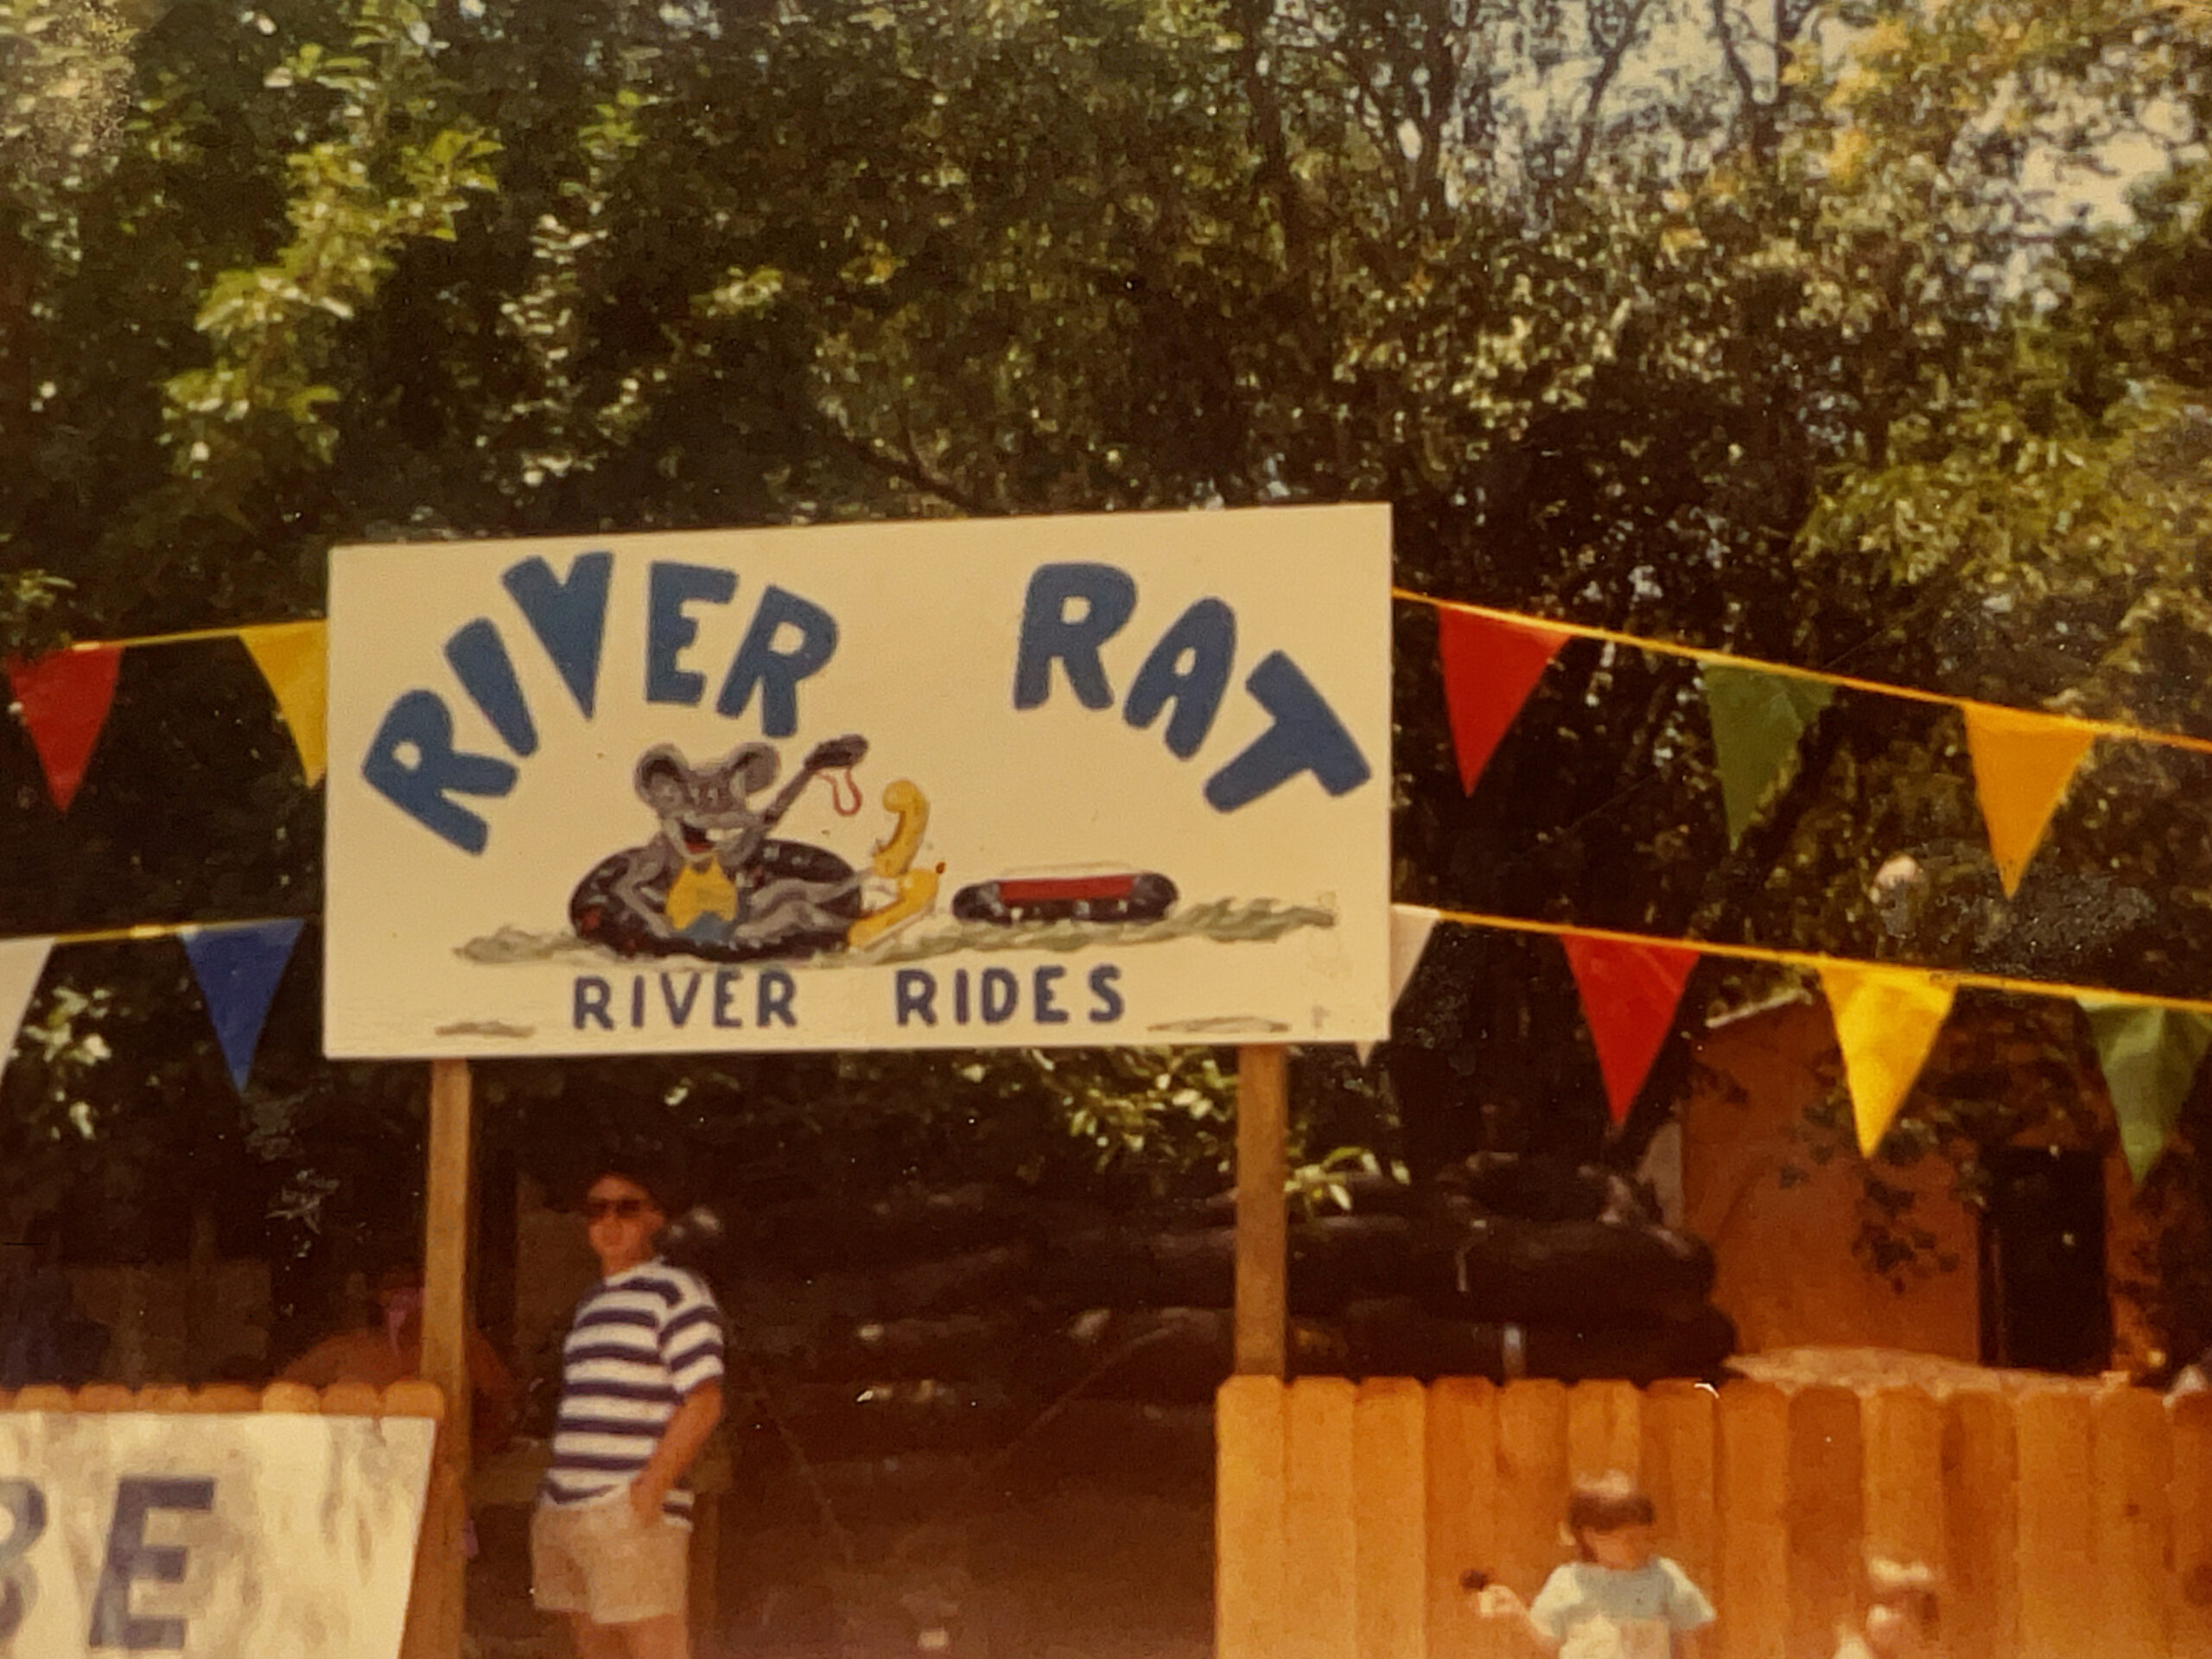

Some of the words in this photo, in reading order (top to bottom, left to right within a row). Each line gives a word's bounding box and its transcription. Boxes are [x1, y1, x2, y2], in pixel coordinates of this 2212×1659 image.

[361, 551, 838, 855] RIVER
[1012, 562, 1370, 814] RAT
[572, 968, 798, 1030] RIVER
[896, 964, 1125, 1027] RIDES
